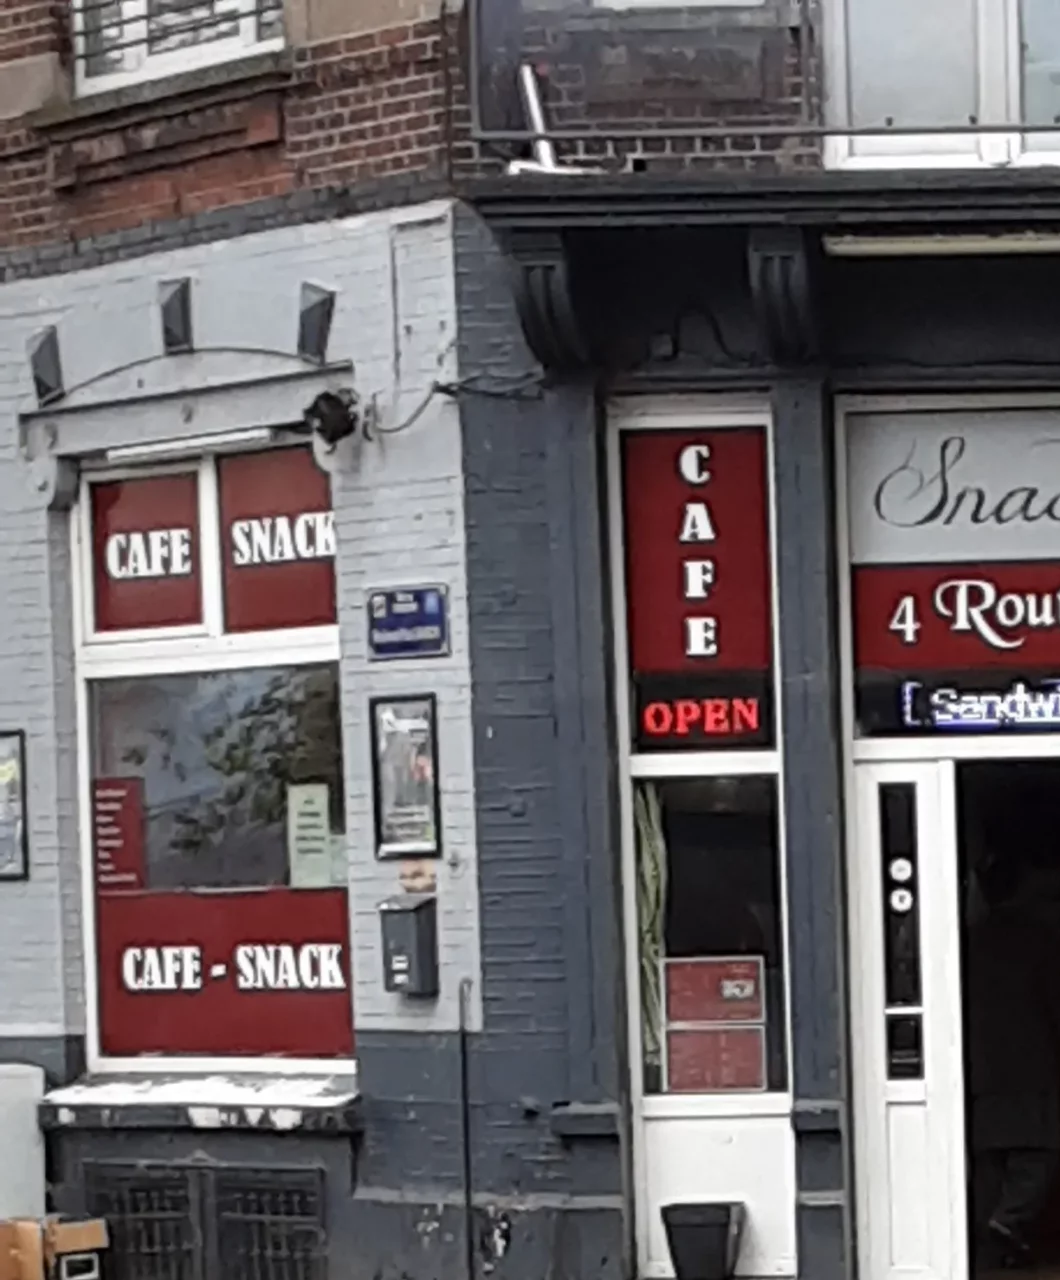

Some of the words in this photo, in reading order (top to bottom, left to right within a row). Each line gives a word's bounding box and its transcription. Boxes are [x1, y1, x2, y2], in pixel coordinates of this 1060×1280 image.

[106, 529, 192, 579] CAFE
[231, 510, 337, 566] SNACK
[680, 446, 717, 655] CAFE
[890, 597, 920, 642] 4
[644, 698, 759, 735] OPEN
[123, 946, 202, 990] CAFE
[236, 944, 346, 988] SNACK
